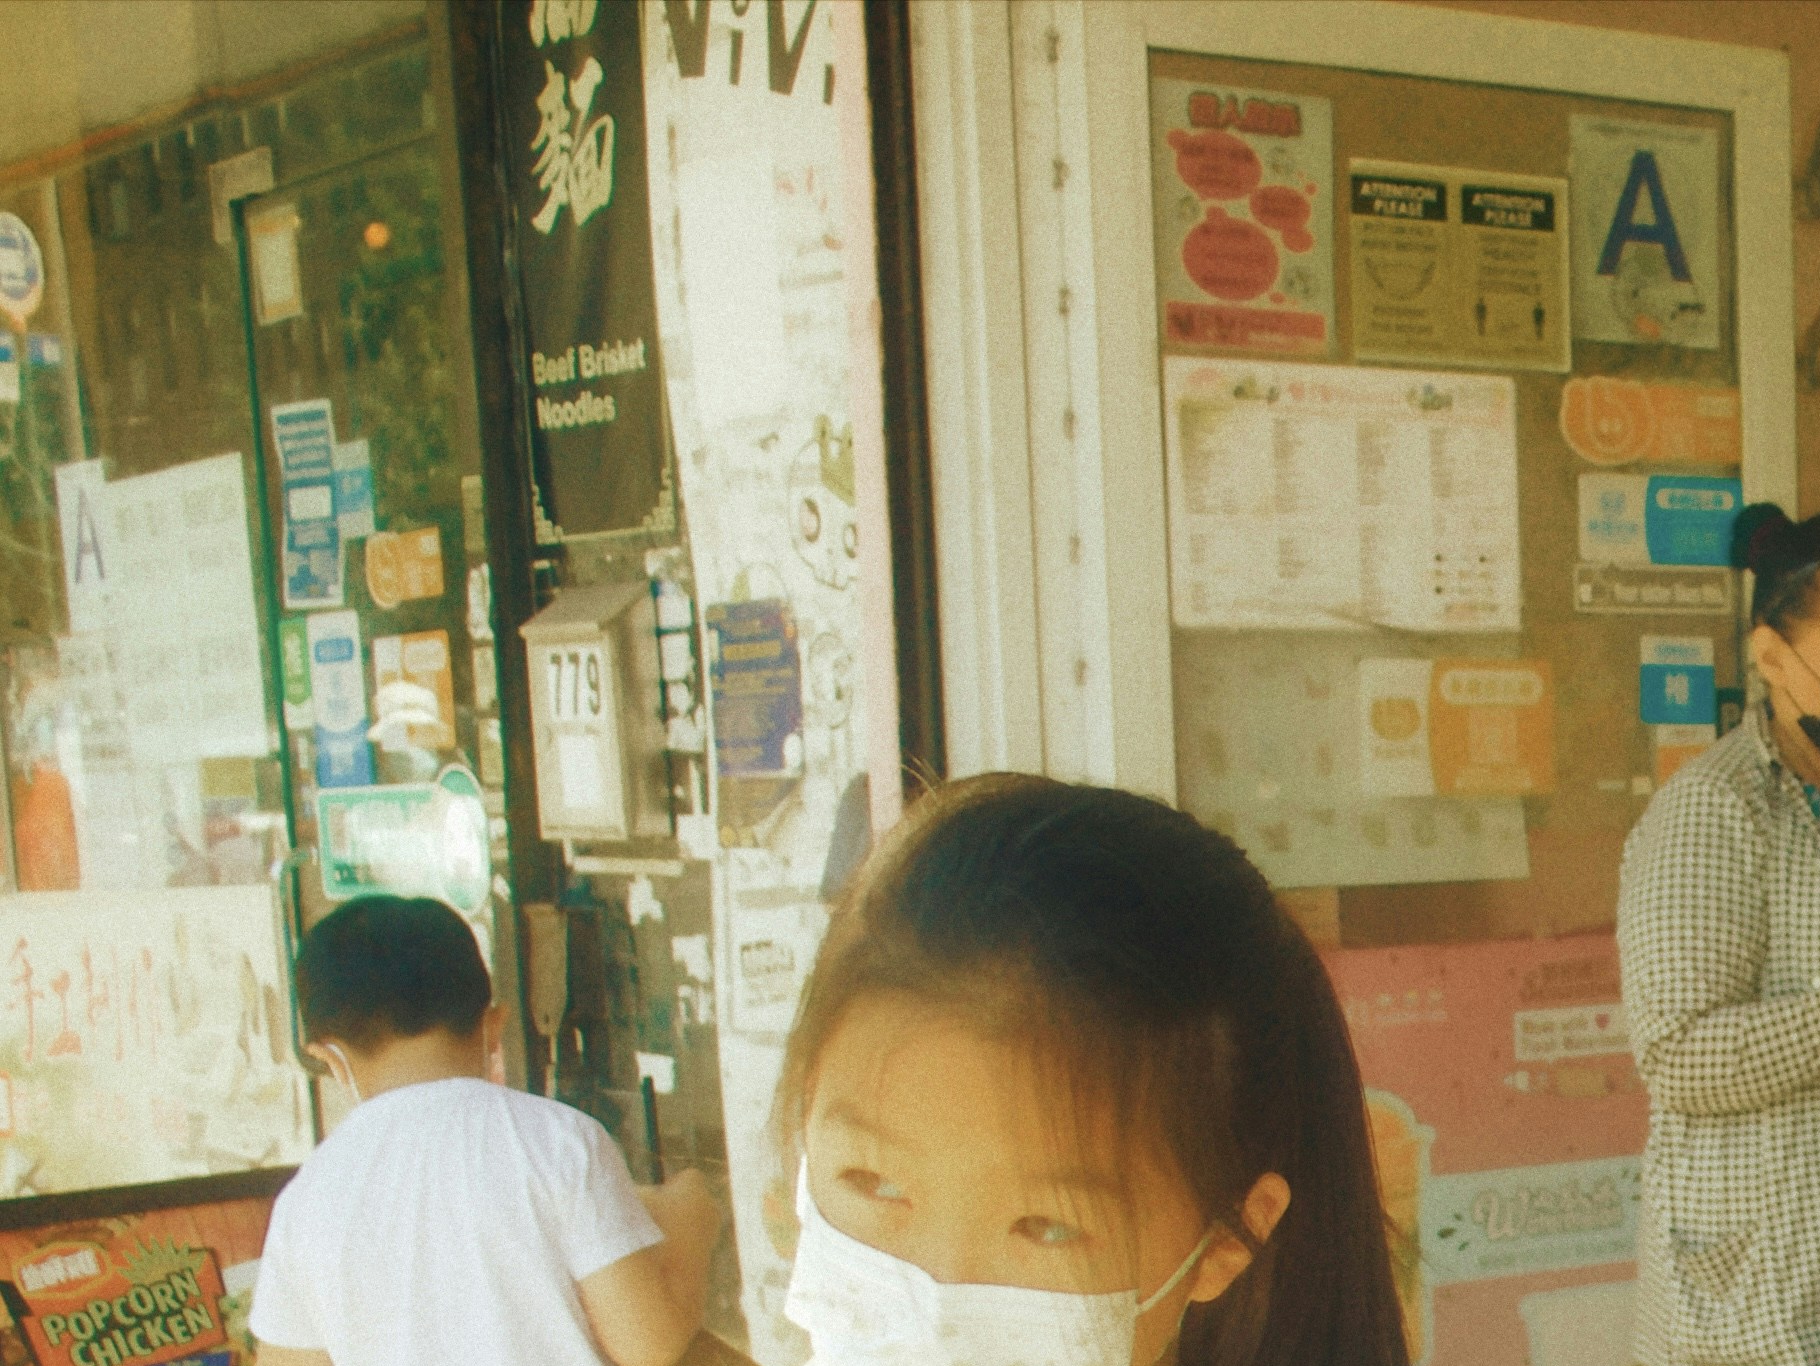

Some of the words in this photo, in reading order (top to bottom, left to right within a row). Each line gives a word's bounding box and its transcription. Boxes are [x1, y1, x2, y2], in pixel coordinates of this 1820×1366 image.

[1360, 180, 1438, 203] ATTENTION
[1373, 198, 1424, 219] PLEASE
[1471, 192, 1546, 213] ATTENTION
[1483, 208, 1532, 228] PLEASE
[1595, 148, 1694, 283] A
[531, 345, 575, 387] Beef
[577, 337, 647, 380] Brisket
[535, 390, 617, 430] Noodles
[74, 485, 106, 585] A
[549, 651, 601, 716] 779
[41, 1266, 202, 1347] POPCORN
